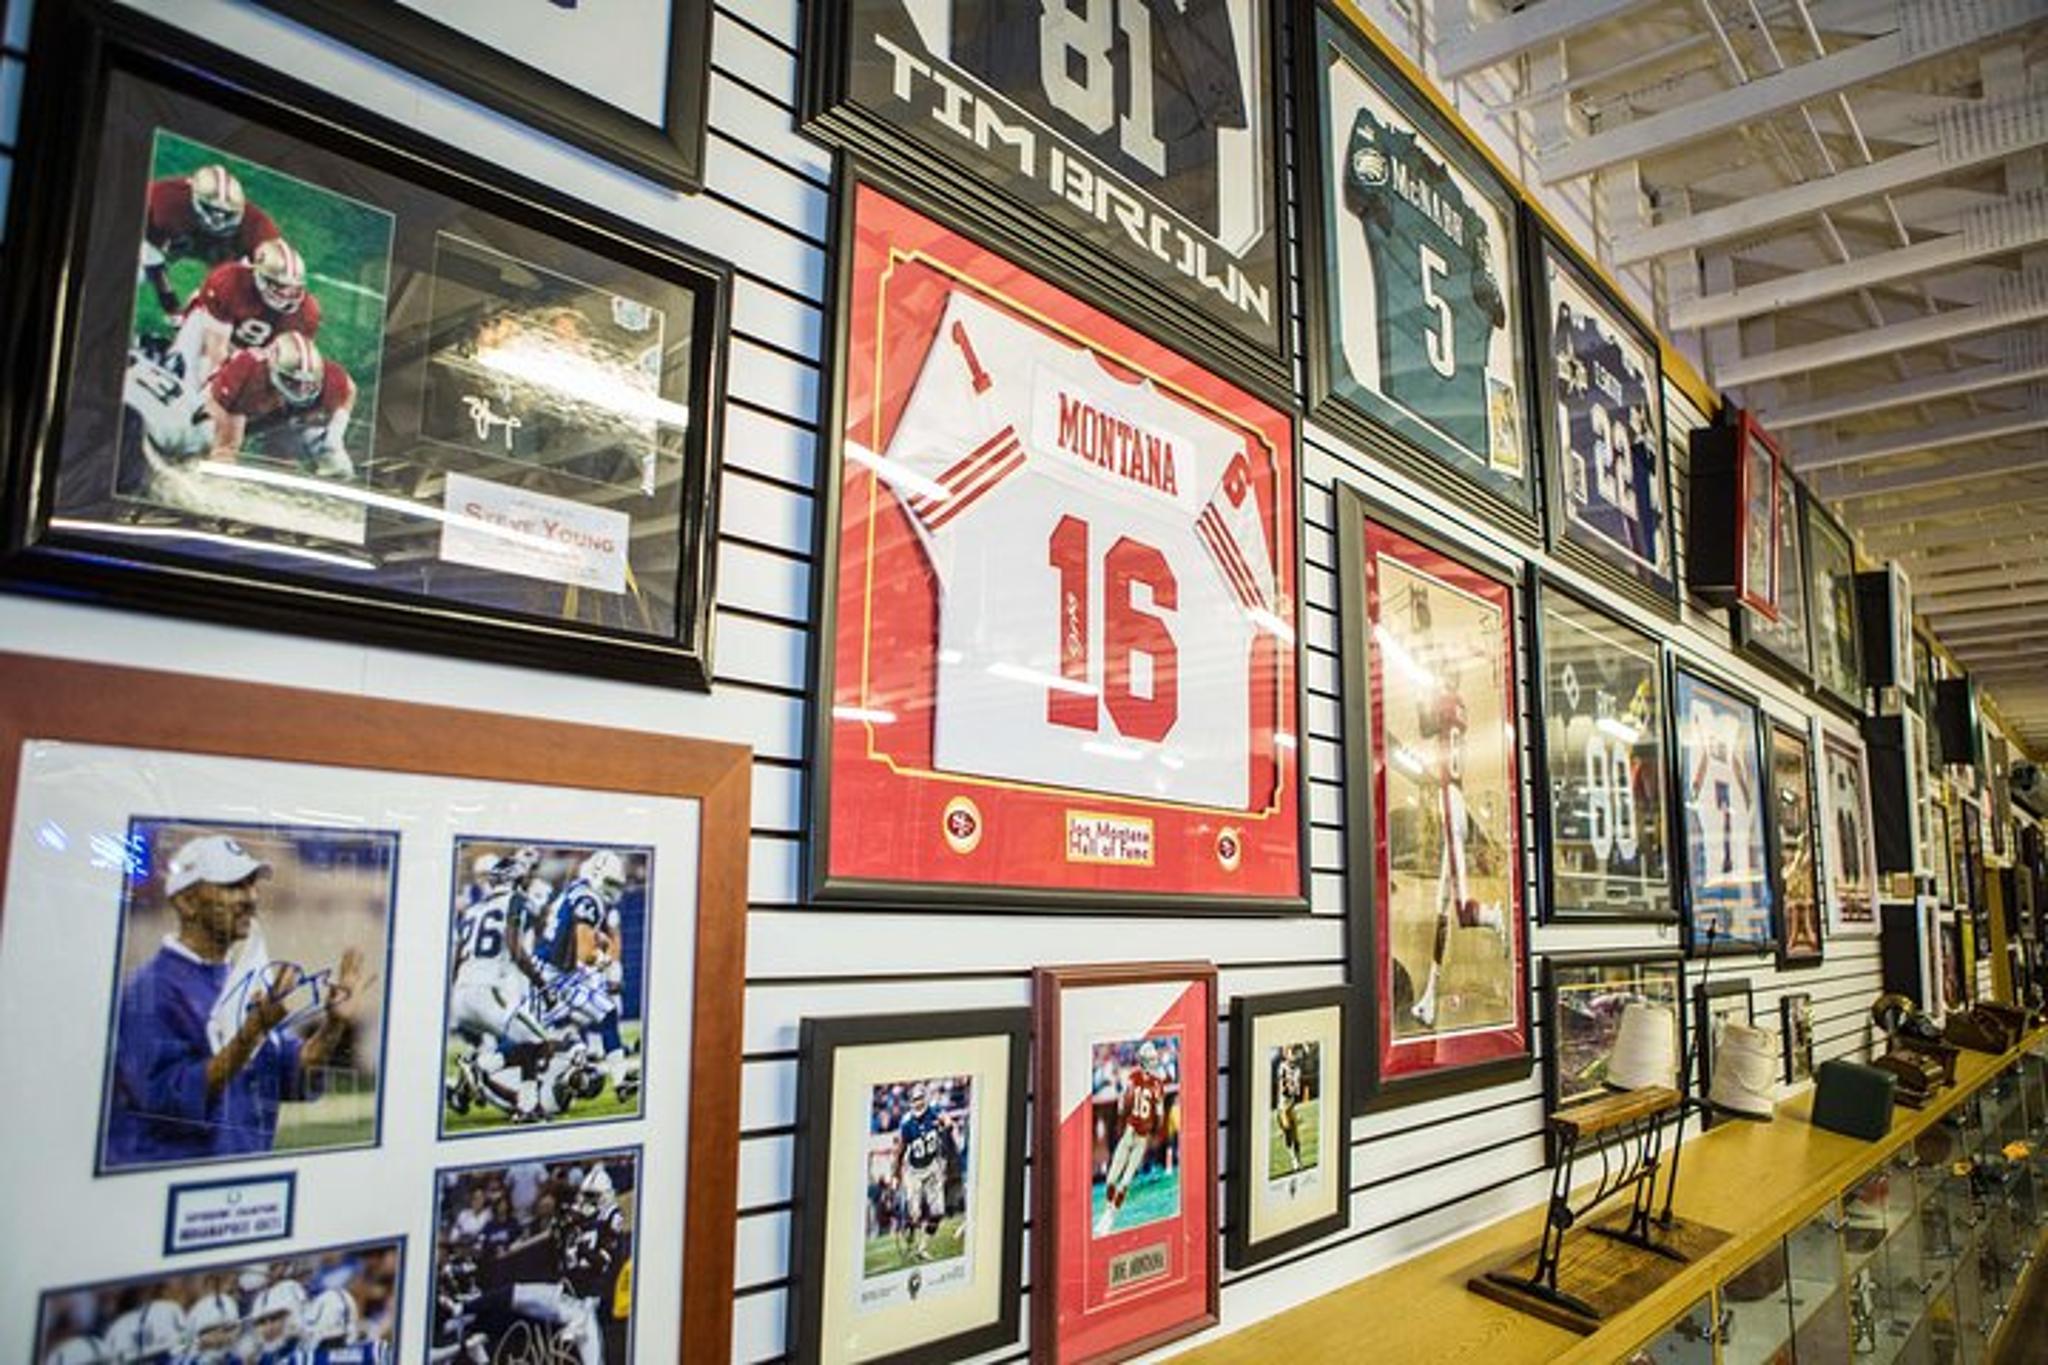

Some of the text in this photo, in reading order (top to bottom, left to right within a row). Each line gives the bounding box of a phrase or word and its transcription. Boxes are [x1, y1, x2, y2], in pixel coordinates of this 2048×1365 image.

[1041, 0, 1167, 178] 81
[875, 33, 1269, 325] TIM BROWN
[1419, 244, 1454, 379] 5
[1058, 392, 1178, 496] MONTANA
[1047, 511, 1178, 743] 16
[1132, 1086, 1150, 1119] 16
